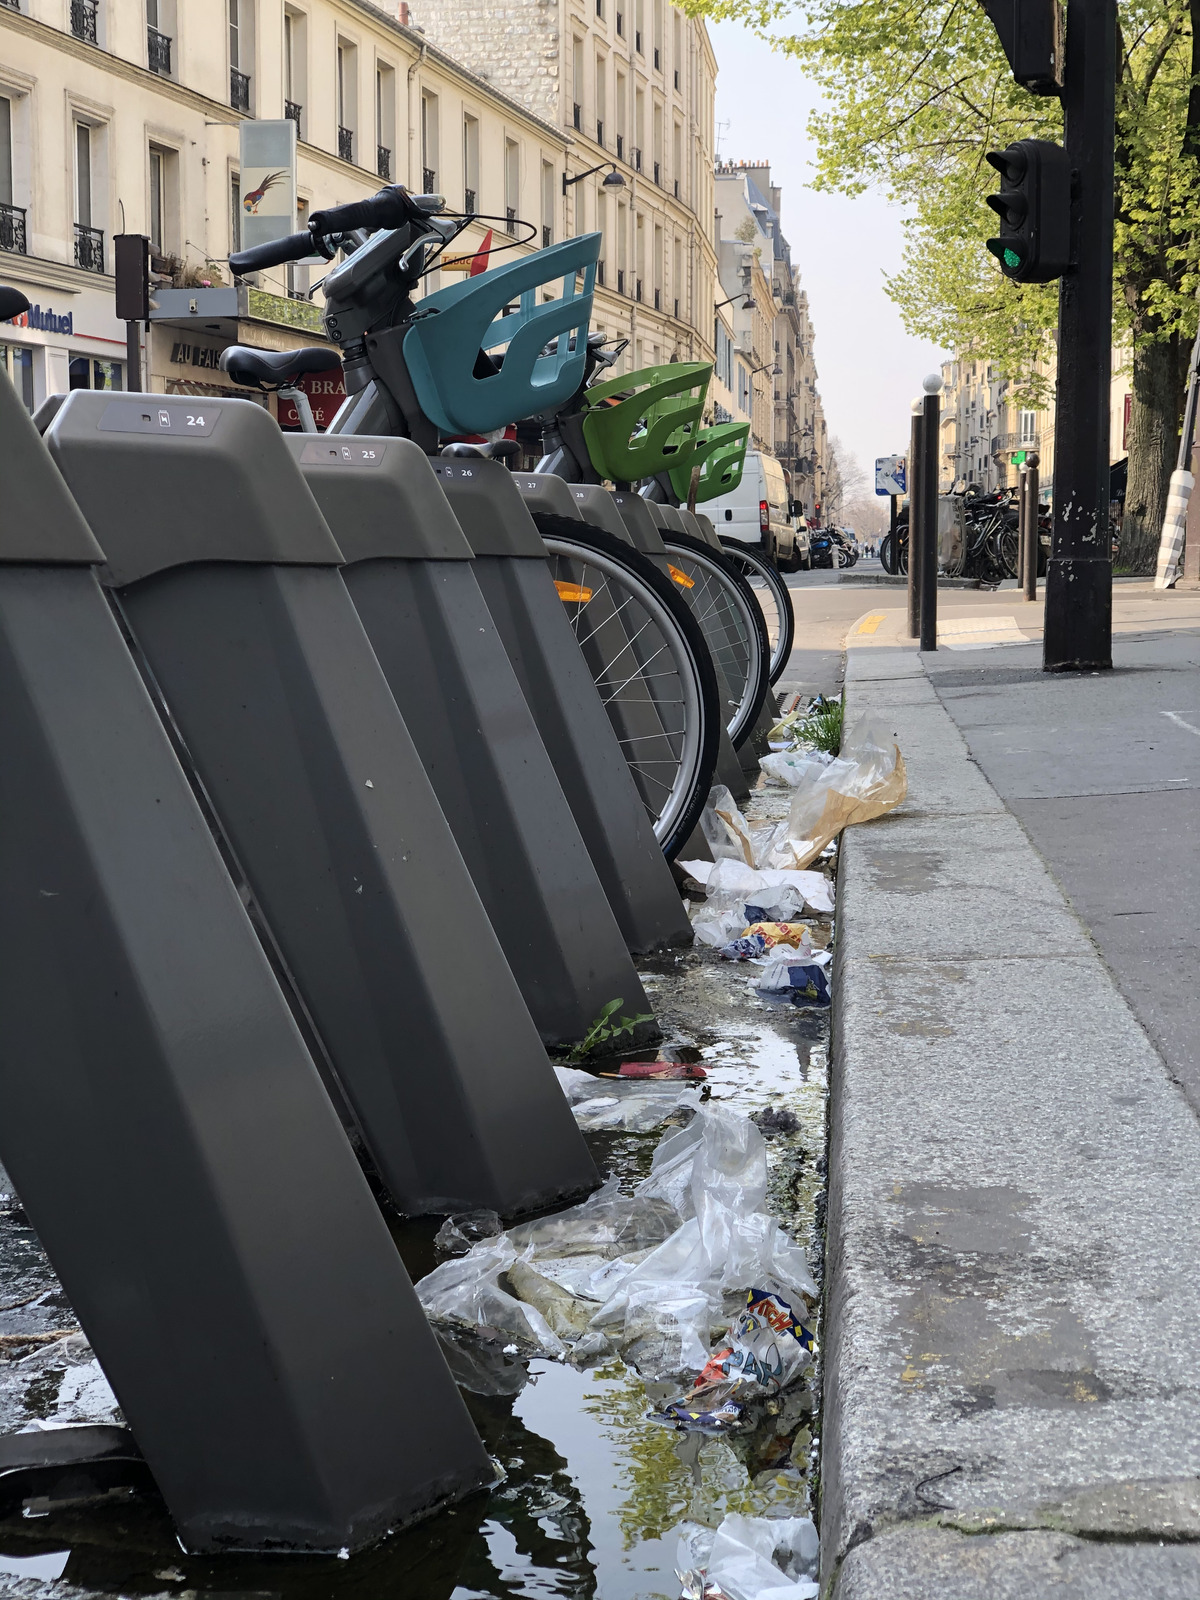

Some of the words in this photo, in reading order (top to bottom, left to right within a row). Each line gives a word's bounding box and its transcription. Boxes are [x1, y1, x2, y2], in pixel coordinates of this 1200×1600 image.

[27, 302, 73, 335] Mutuel
[174, 343, 191, 363] AU
[186, 415, 205, 426] 24
[361, 450, 376, 459] 25
[461, 469, 473, 477] 26
